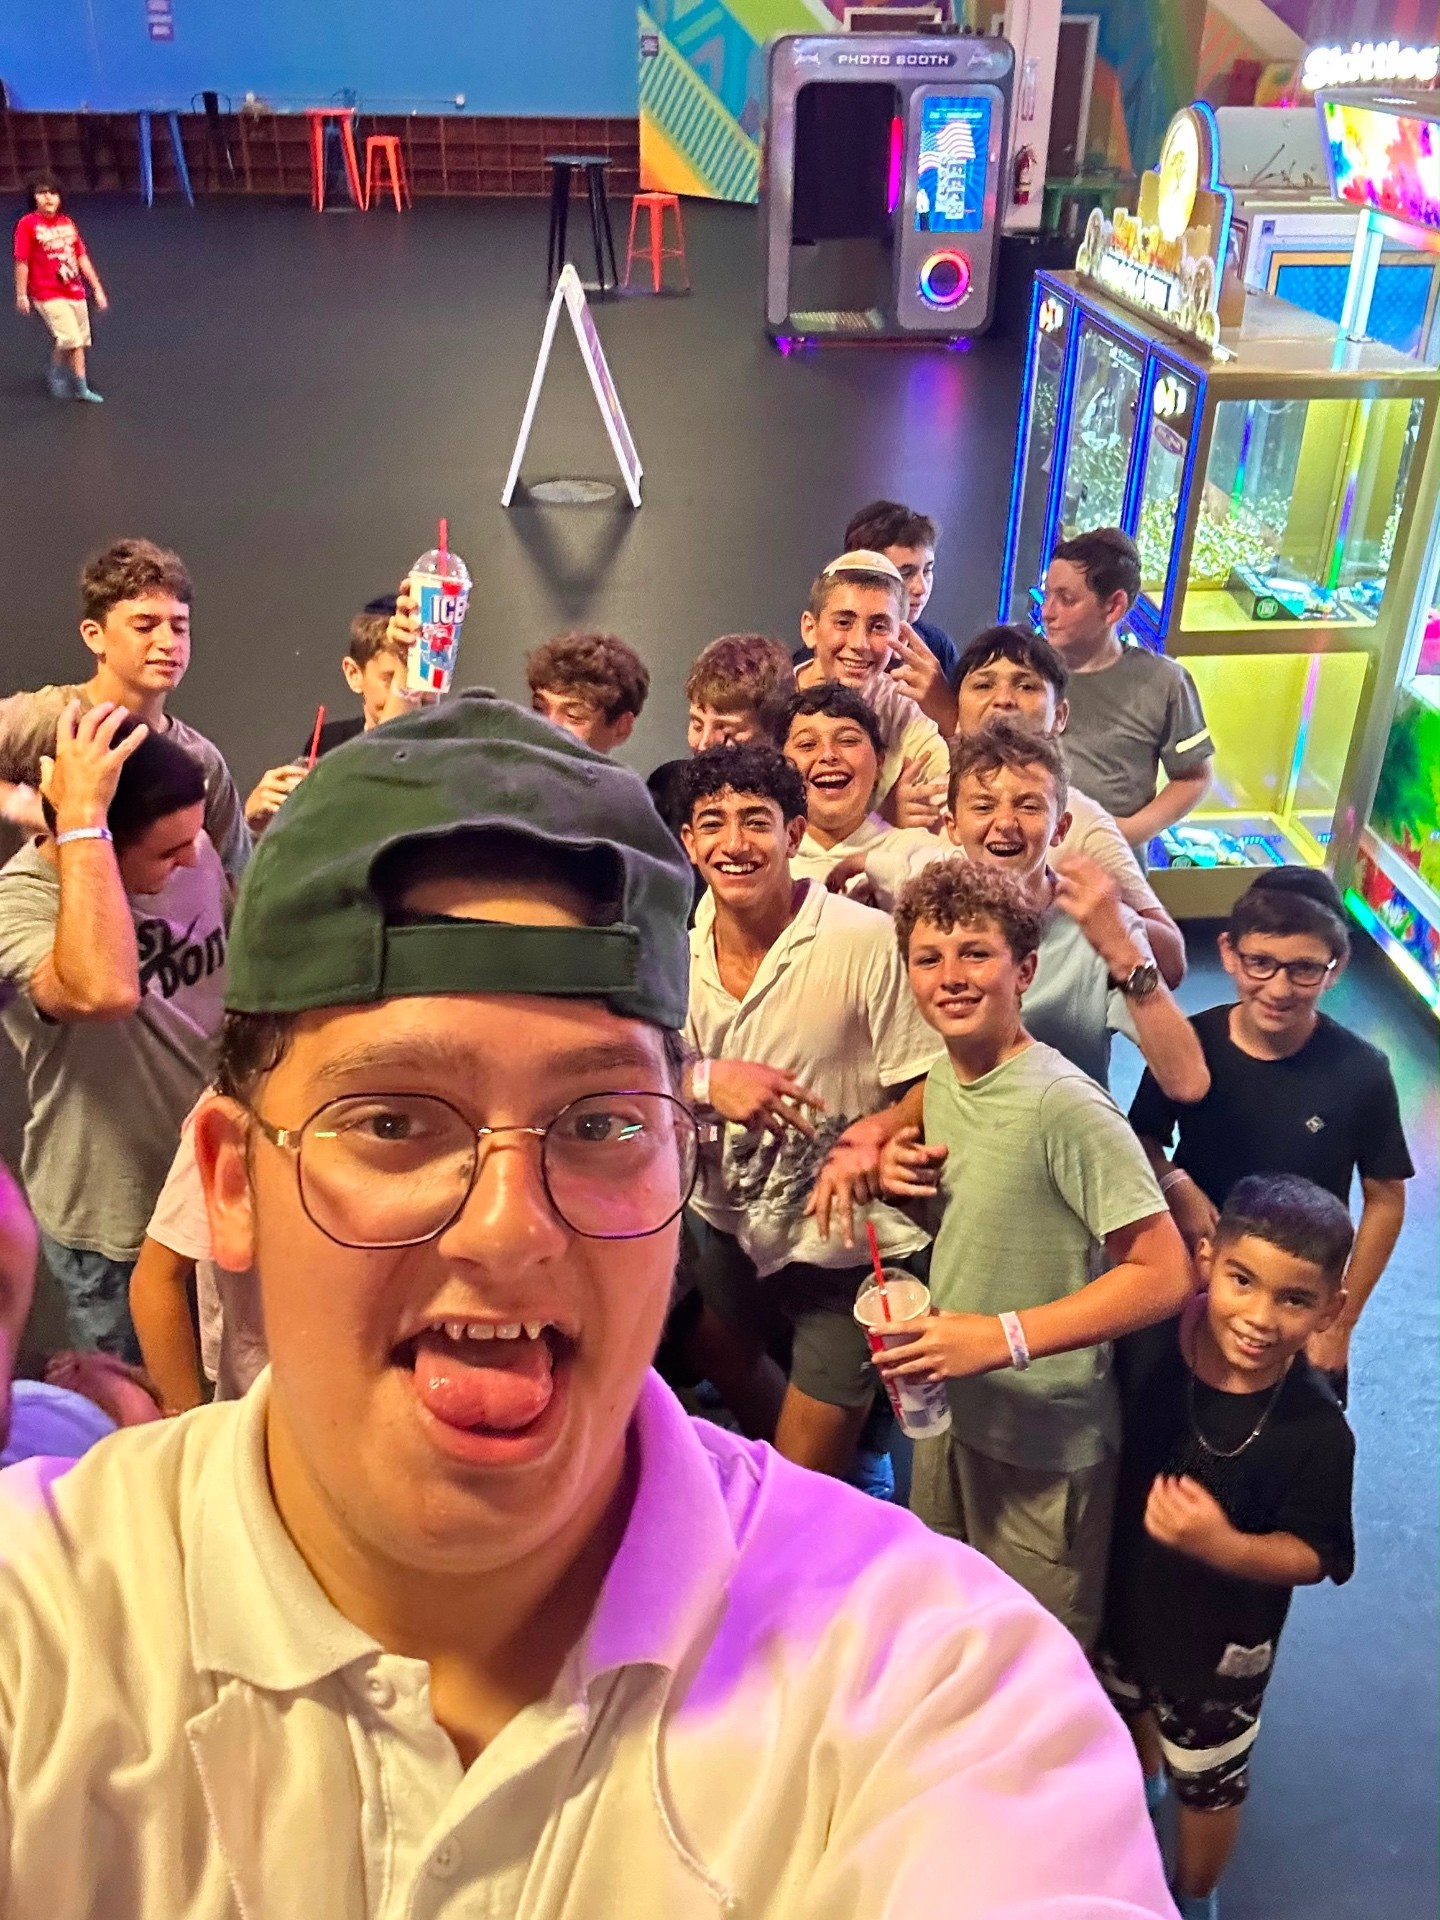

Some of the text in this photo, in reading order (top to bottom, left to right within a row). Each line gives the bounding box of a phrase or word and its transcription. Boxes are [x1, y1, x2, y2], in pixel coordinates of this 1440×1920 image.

[838, 54, 949, 65] PHOTO BOOTH
[1302, 40, 1439, 90] Skittles
